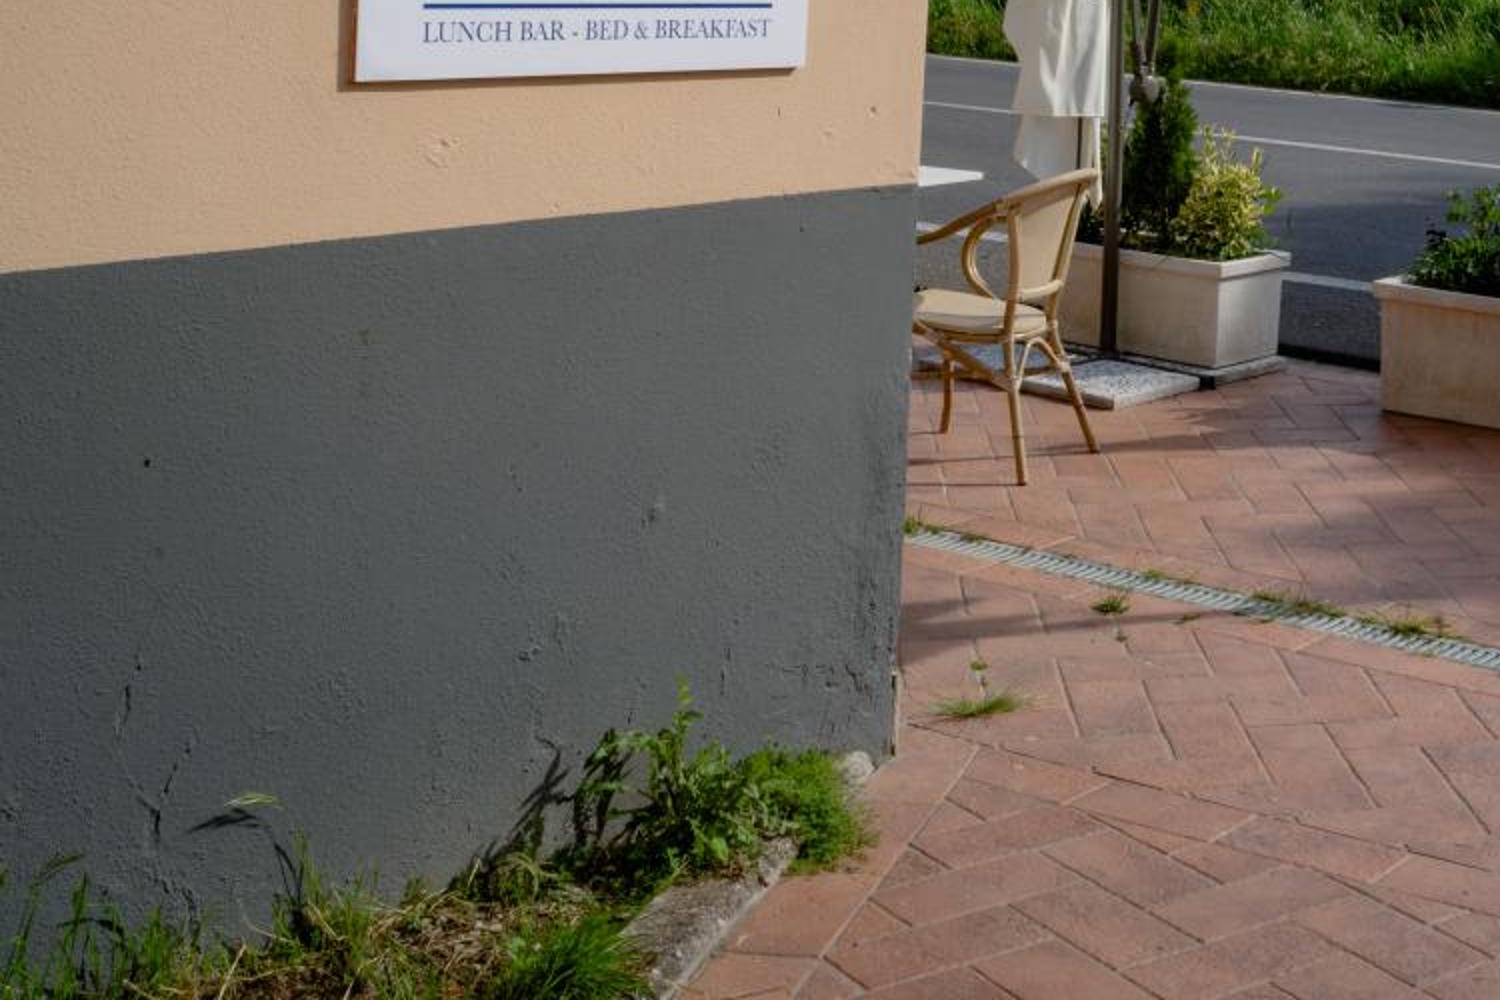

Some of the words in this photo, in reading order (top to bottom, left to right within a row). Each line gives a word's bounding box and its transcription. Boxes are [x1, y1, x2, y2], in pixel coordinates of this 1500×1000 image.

[423, 21, 512, 43] LUNCH
[520, 20, 565, 41] BAR
[585, 19, 629, 41] BED
[633, 20, 649, 40] &
[655, 18, 774, 39] BREAKFAST
